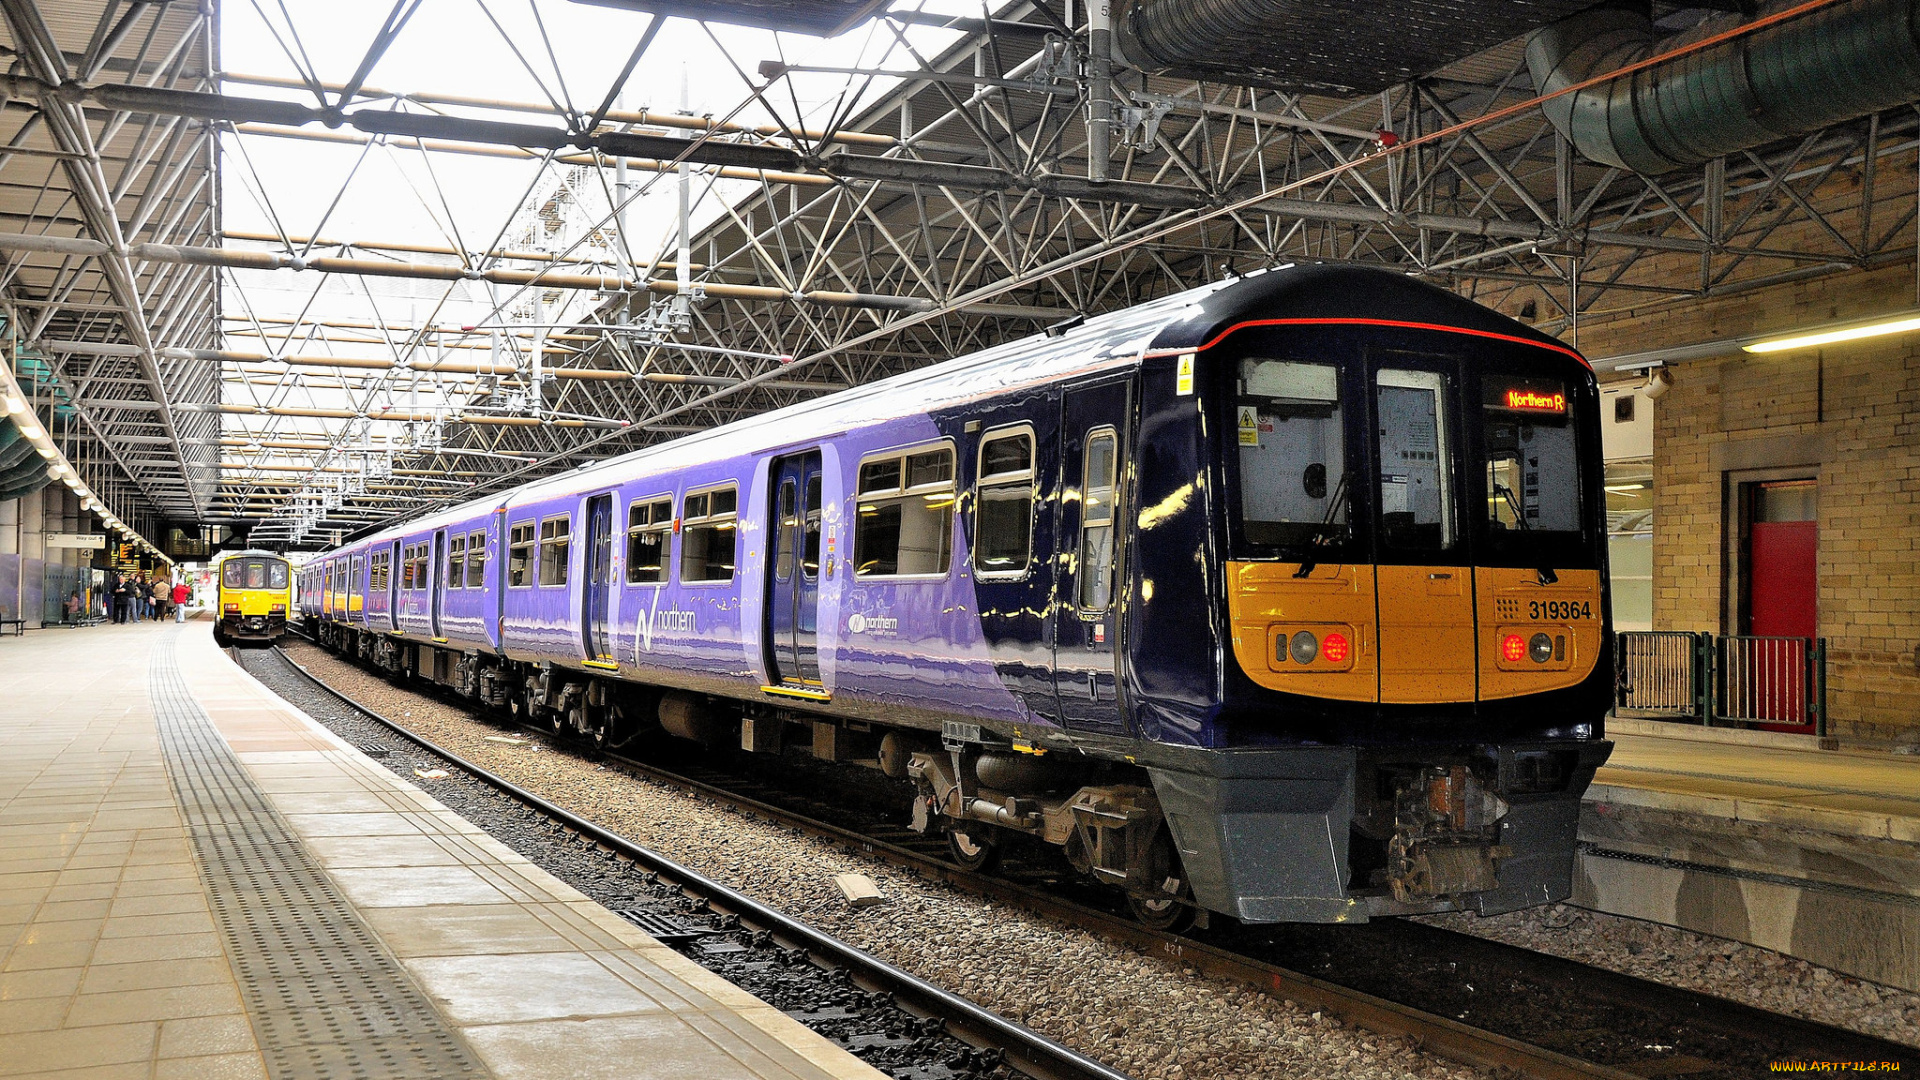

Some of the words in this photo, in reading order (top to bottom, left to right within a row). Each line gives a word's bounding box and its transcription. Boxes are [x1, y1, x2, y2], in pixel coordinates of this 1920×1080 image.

[1509, 391, 1554, 408] Northern
[657, 600, 696, 631] northern
[1528, 600, 1592, 620] 319364
[865, 614, 898, 629] northern
